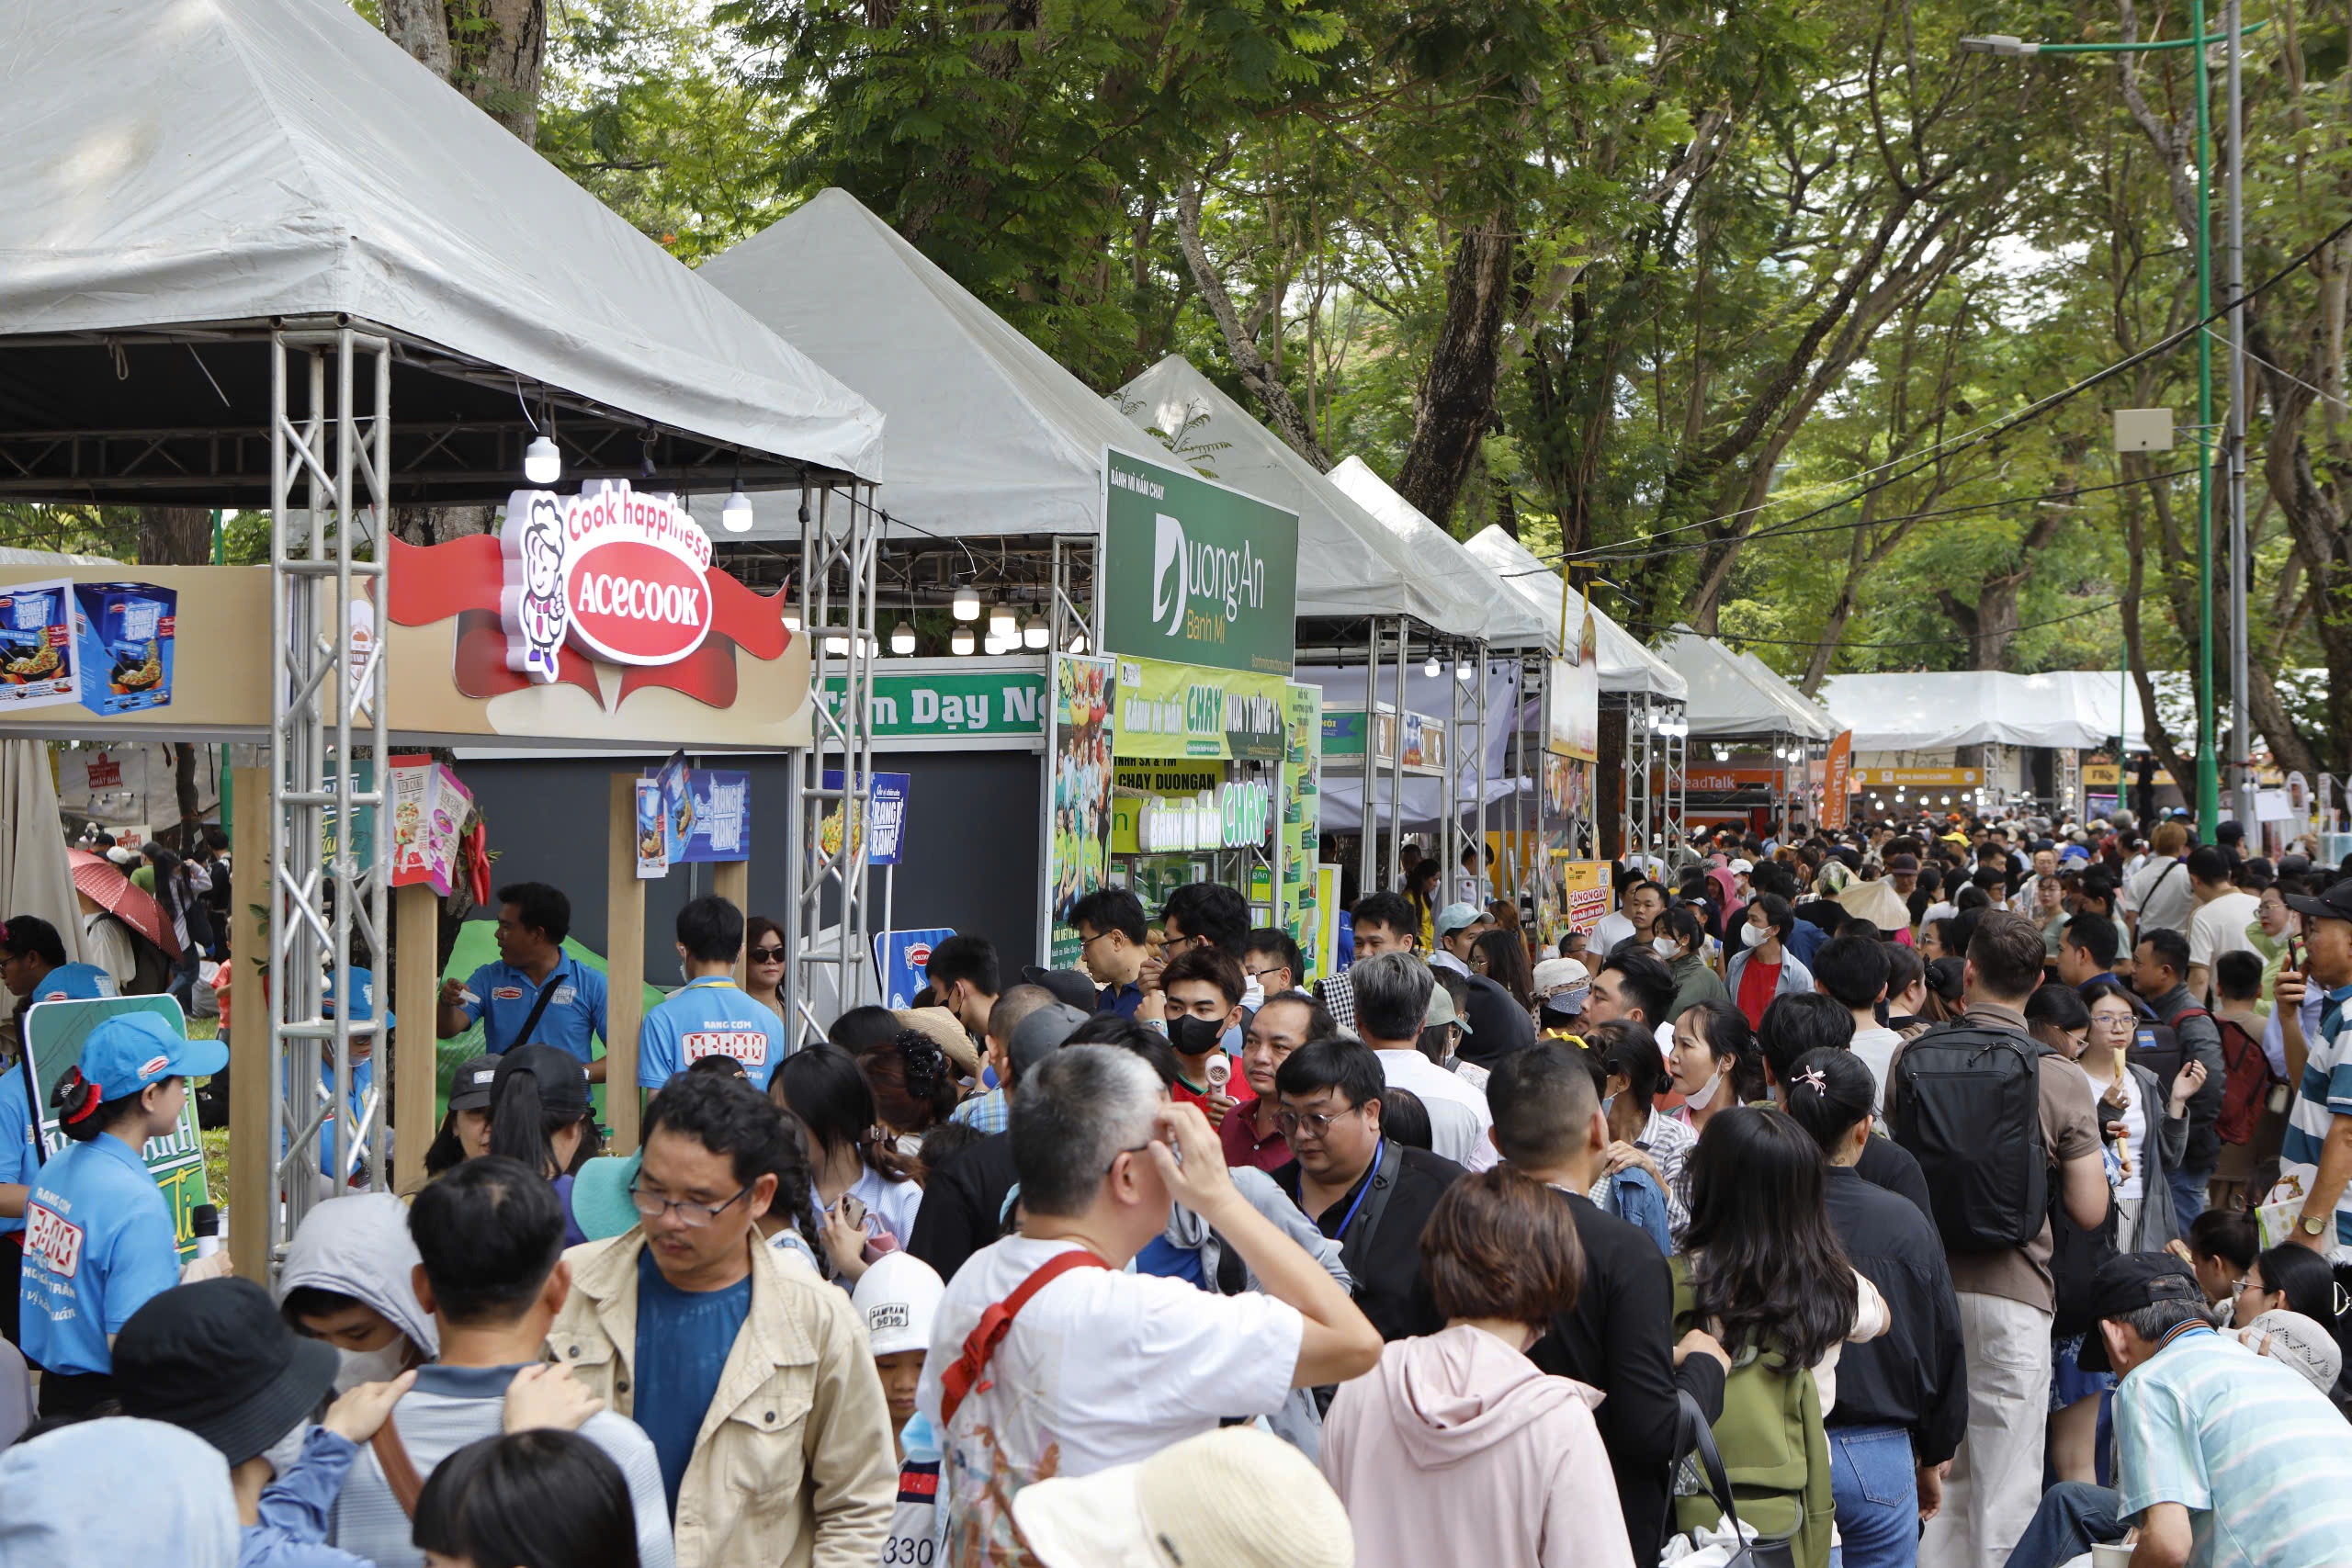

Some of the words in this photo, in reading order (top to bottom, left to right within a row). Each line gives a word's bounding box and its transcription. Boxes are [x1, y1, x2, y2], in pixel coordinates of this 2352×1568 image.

[1111, 466, 1126, 489] BÁNH
[1128, 471, 1136, 491] MÌ
[1149, 482, 1164, 500] CHAY
[569, 490, 616, 541] Cook
[623, 489, 709, 567] happiness
[1187, 609, 1212, 641] Banh
[911, 689, 988, 729] Dạy
[1186, 683, 1223, 735] CHAY
[1226, 694, 1243, 733] MUA
[1118, 773, 1150, 790] CHAY
[1156, 773, 1216, 790] DUONGAN
[1670, 774, 1736, 789] BeadTalk
[1222, 781, 1268, 848] CHAY
[1588, 887, 1608, 900] NGAY
[883, 1536, 933, 1565] 330
